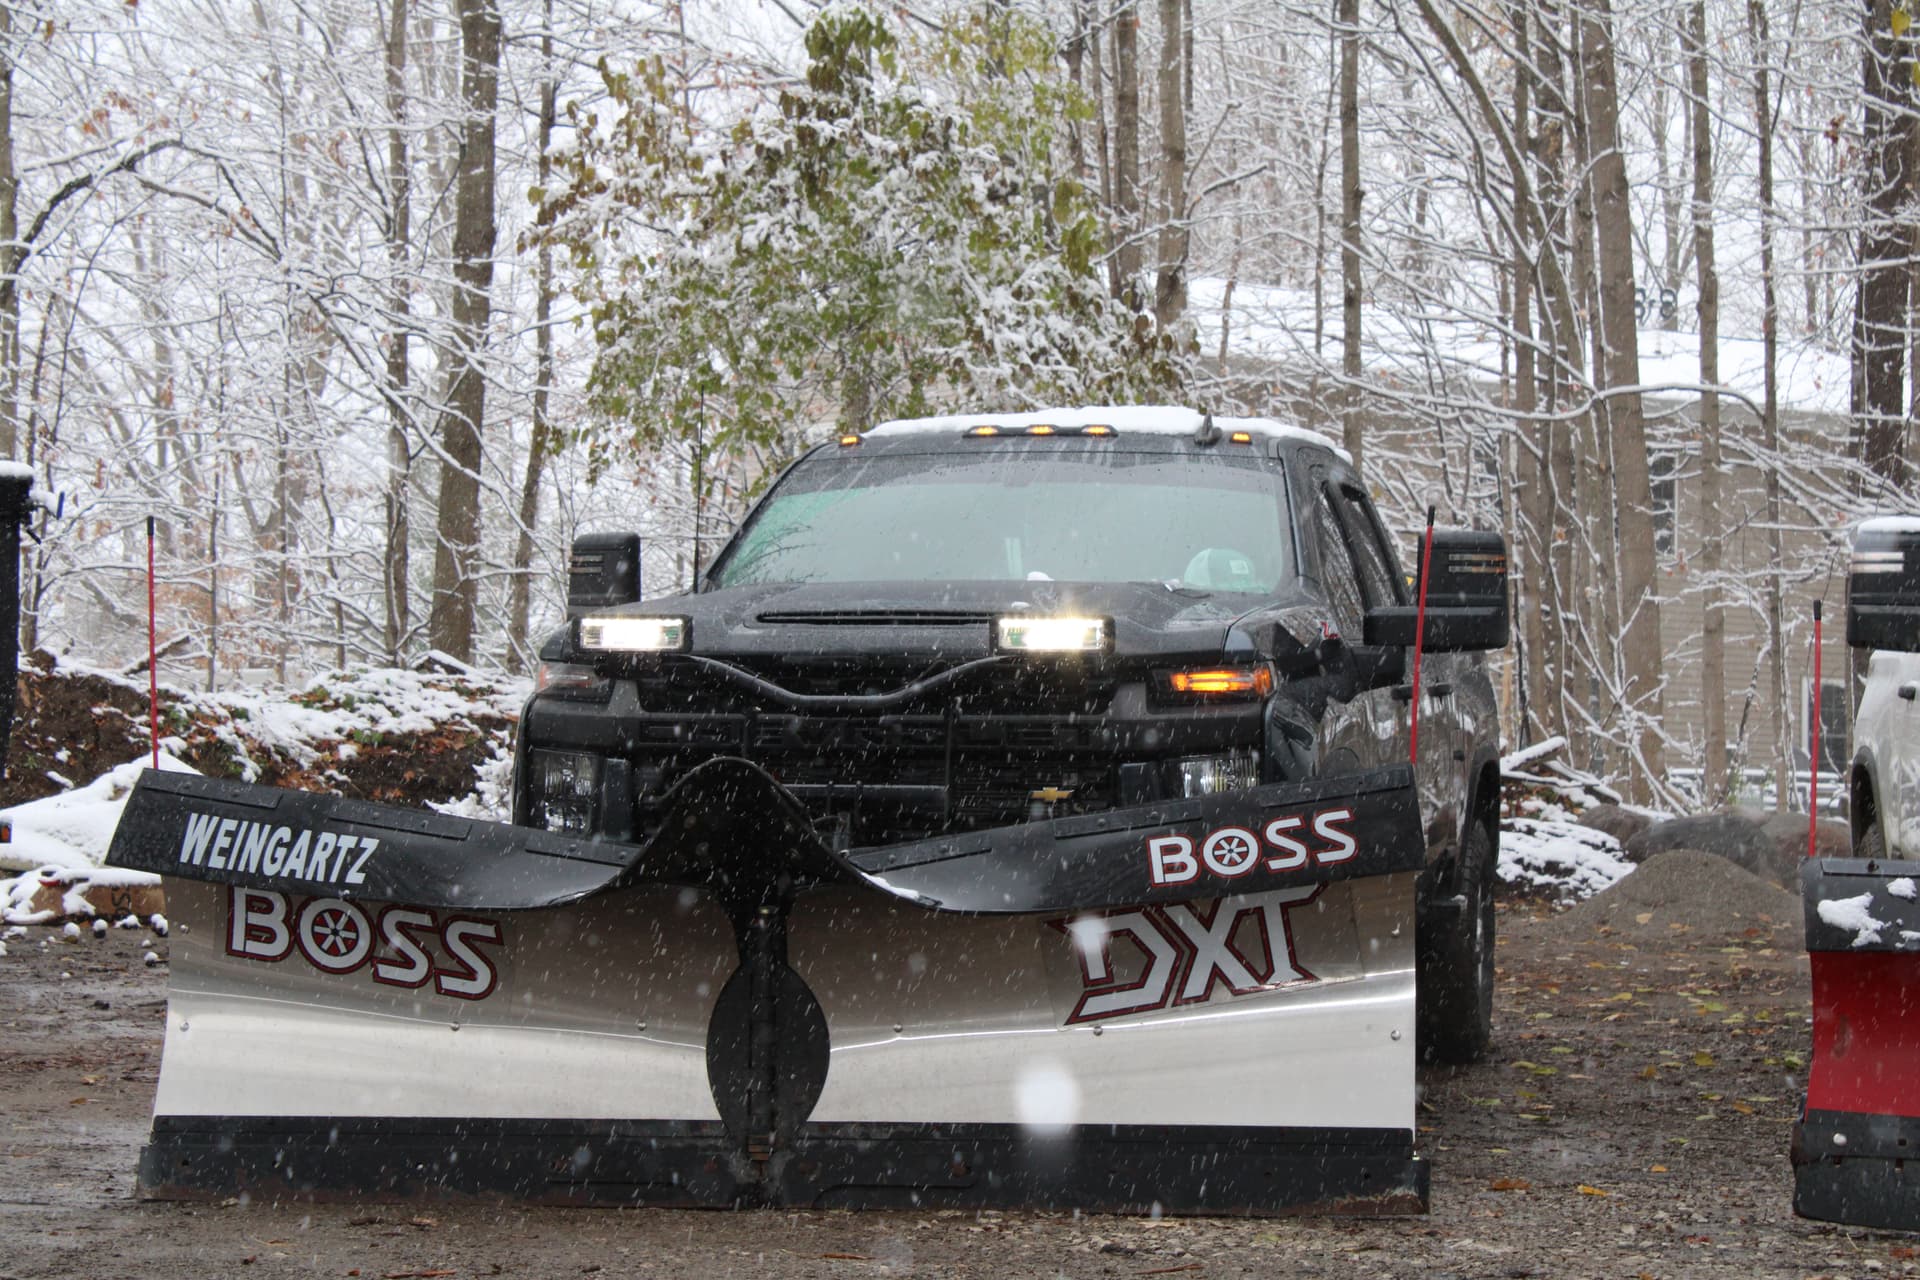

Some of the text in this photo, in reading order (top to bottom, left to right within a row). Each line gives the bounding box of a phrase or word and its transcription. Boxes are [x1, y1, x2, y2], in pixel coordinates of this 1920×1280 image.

[179, 812, 380, 884] WEINGARTZ
[1146, 807, 1359, 888] BOSS
[225, 882, 505, 1000] BOSS
[1052, 882, 1326, 1026] DXT
